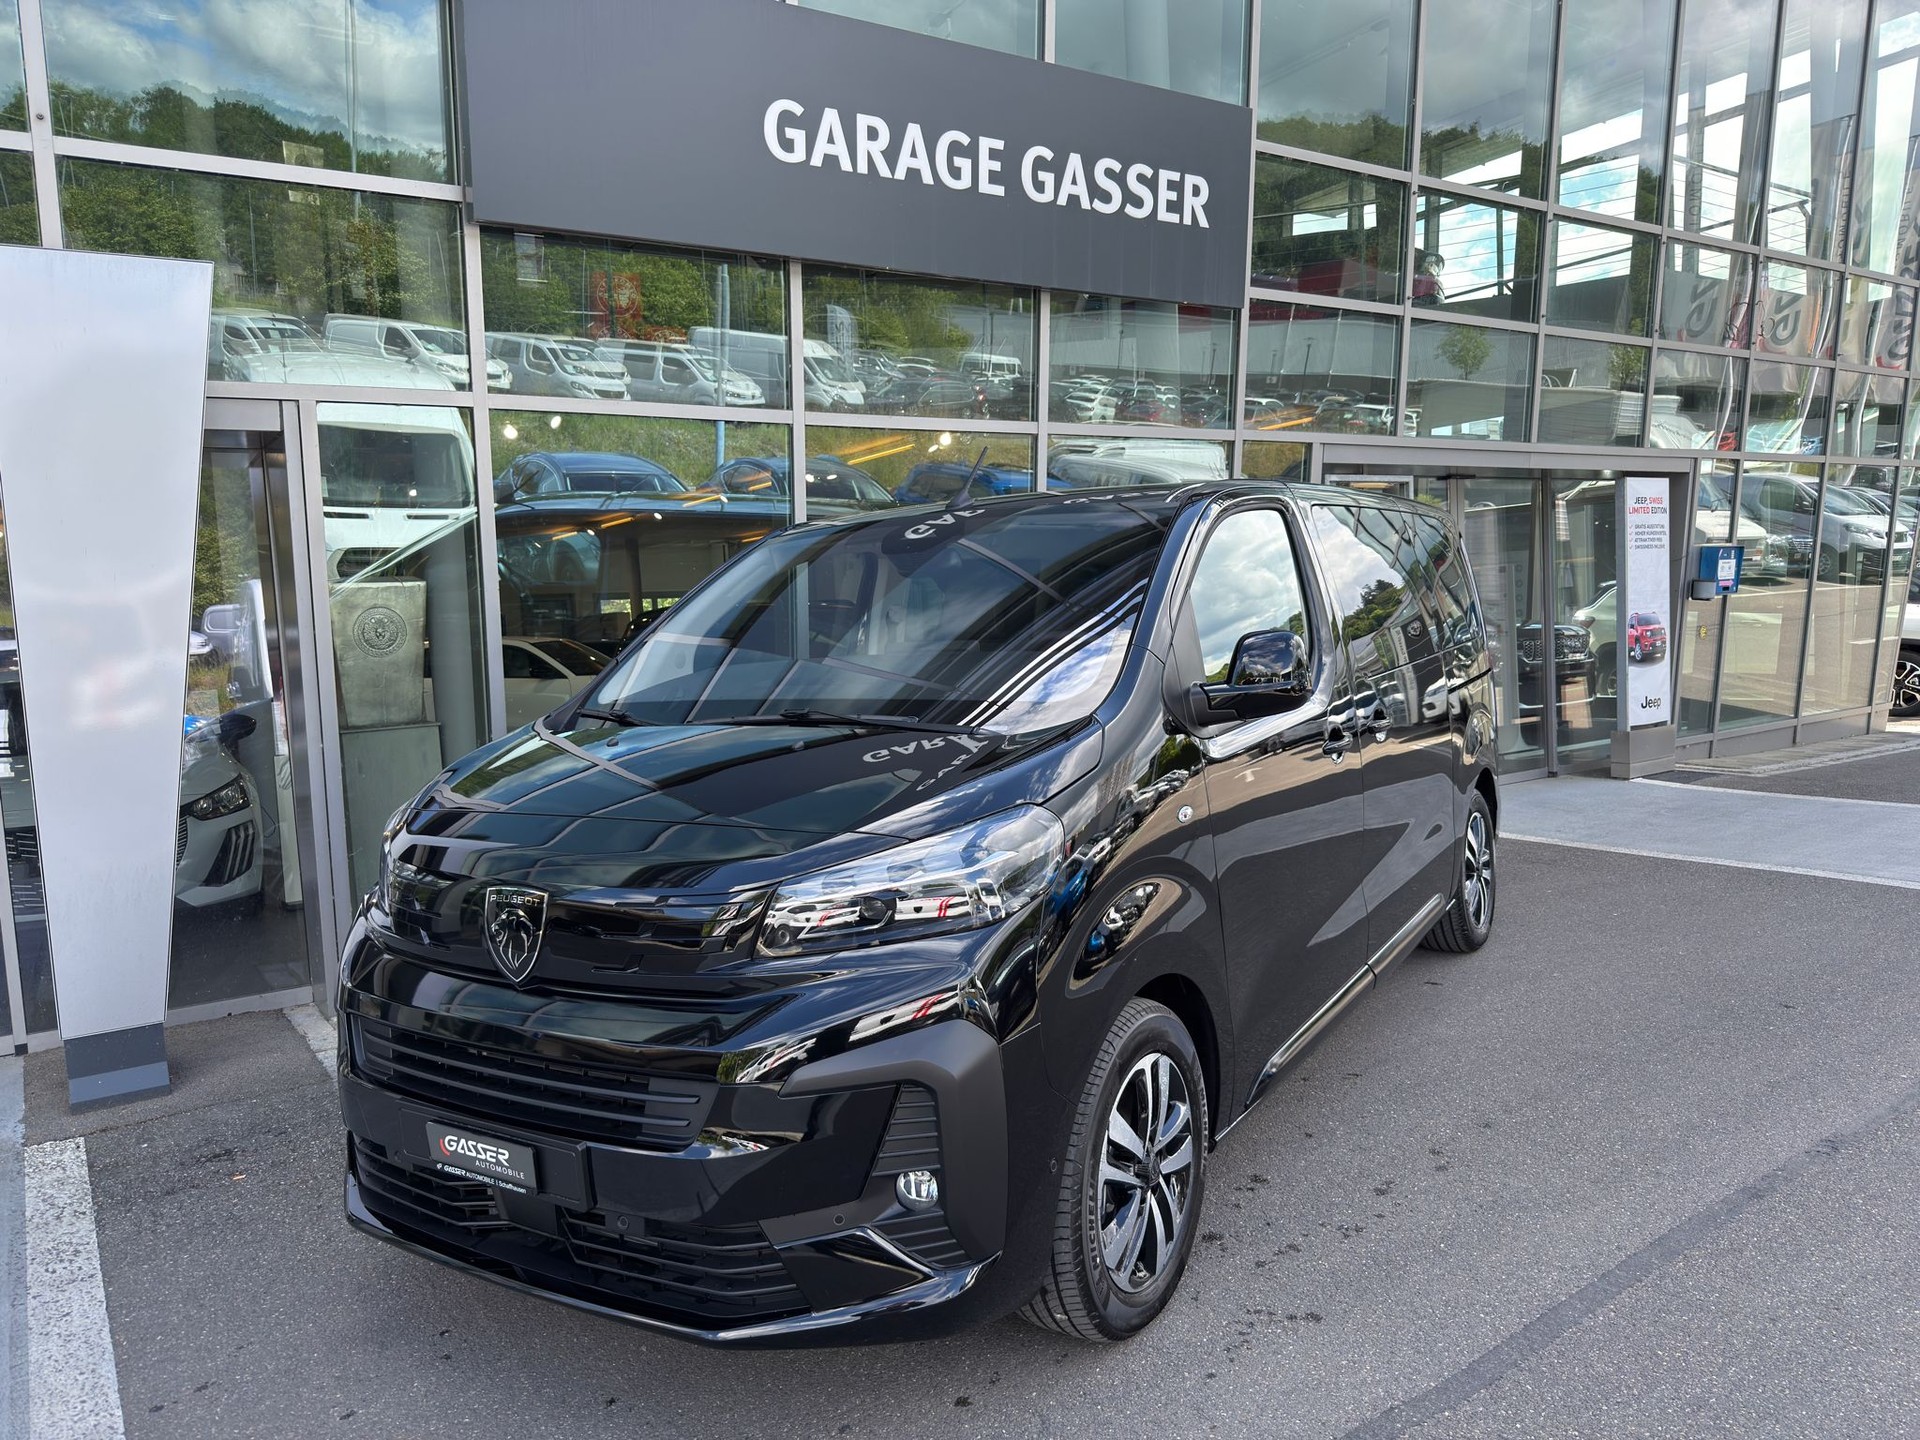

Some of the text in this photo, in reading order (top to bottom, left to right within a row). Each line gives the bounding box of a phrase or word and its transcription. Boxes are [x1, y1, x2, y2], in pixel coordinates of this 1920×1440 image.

[763, 98, 1210, 229] GARAGE GASSER
[1648, 496, 1664, 505] SWISS
[1628, 506, 1668, 515] LIMITED EDITION
[1641, 696, 1662, 709] Jeep
[490, 894, 541, 906] PEUGEOT
[444, 1135, 510, 1167] GASSER
[444, 1165, 466, 1176] GASSER
[466, 1171, 495, 1185] AUTOMOBILE
[475, 1160, 525, 1180] AUTOMOBILE
